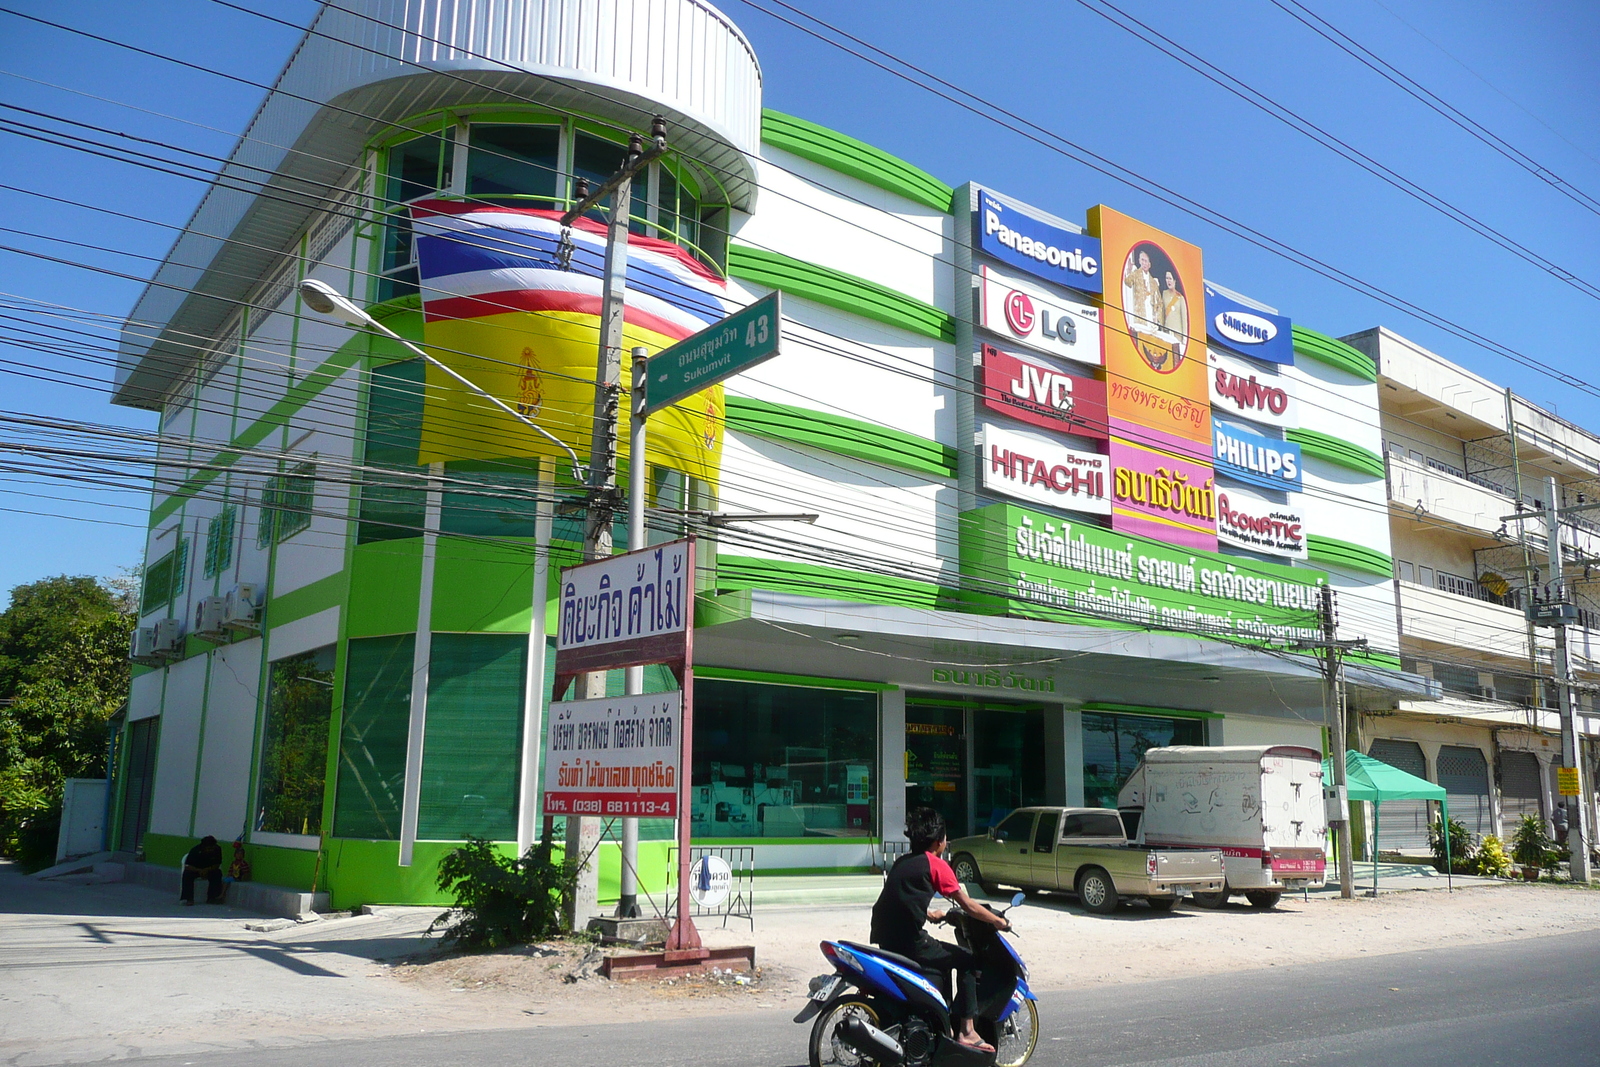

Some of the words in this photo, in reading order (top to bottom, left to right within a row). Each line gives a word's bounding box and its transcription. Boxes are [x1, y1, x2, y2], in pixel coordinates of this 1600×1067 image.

[985, 208, 1098, 275] Panasonic
[678, 327, 738, 367] ถนนสุขุมวิท
[745, 314, 769, 348] 43
[1041, 309, 1077, 344] LG
[1222, 312, 1269, 341] SAMSUNG
[683, 352, 731, 383] Sukumvit
[1011, 364, 1074, 411] JVC
[1215, 367, 1288, 414] SANYO
[1111, 382, 1208, 428] ทรงพระเจริญ
[991, 444, 1104, 498] HITACHI
[1216, 430, 1297, 479] PHILIPS
[562, 573, 623, 645] ติยะกิจ
[627, 548, 682, 635] ค้าไม้
[1137, 556, 1196, 592] รถยนต์
[552, 709, 575, 751] บริษัท
[648, 702, 672, 747] จำกัด
[558, 757, 583, 787] รับทำ
[632, 760, 675, 797] ทุกชนิด
[546, 793, 568, 811] โทร.
[572, 799, 602, 813] (038)
[606, 801, 670, 813] 681113-4
